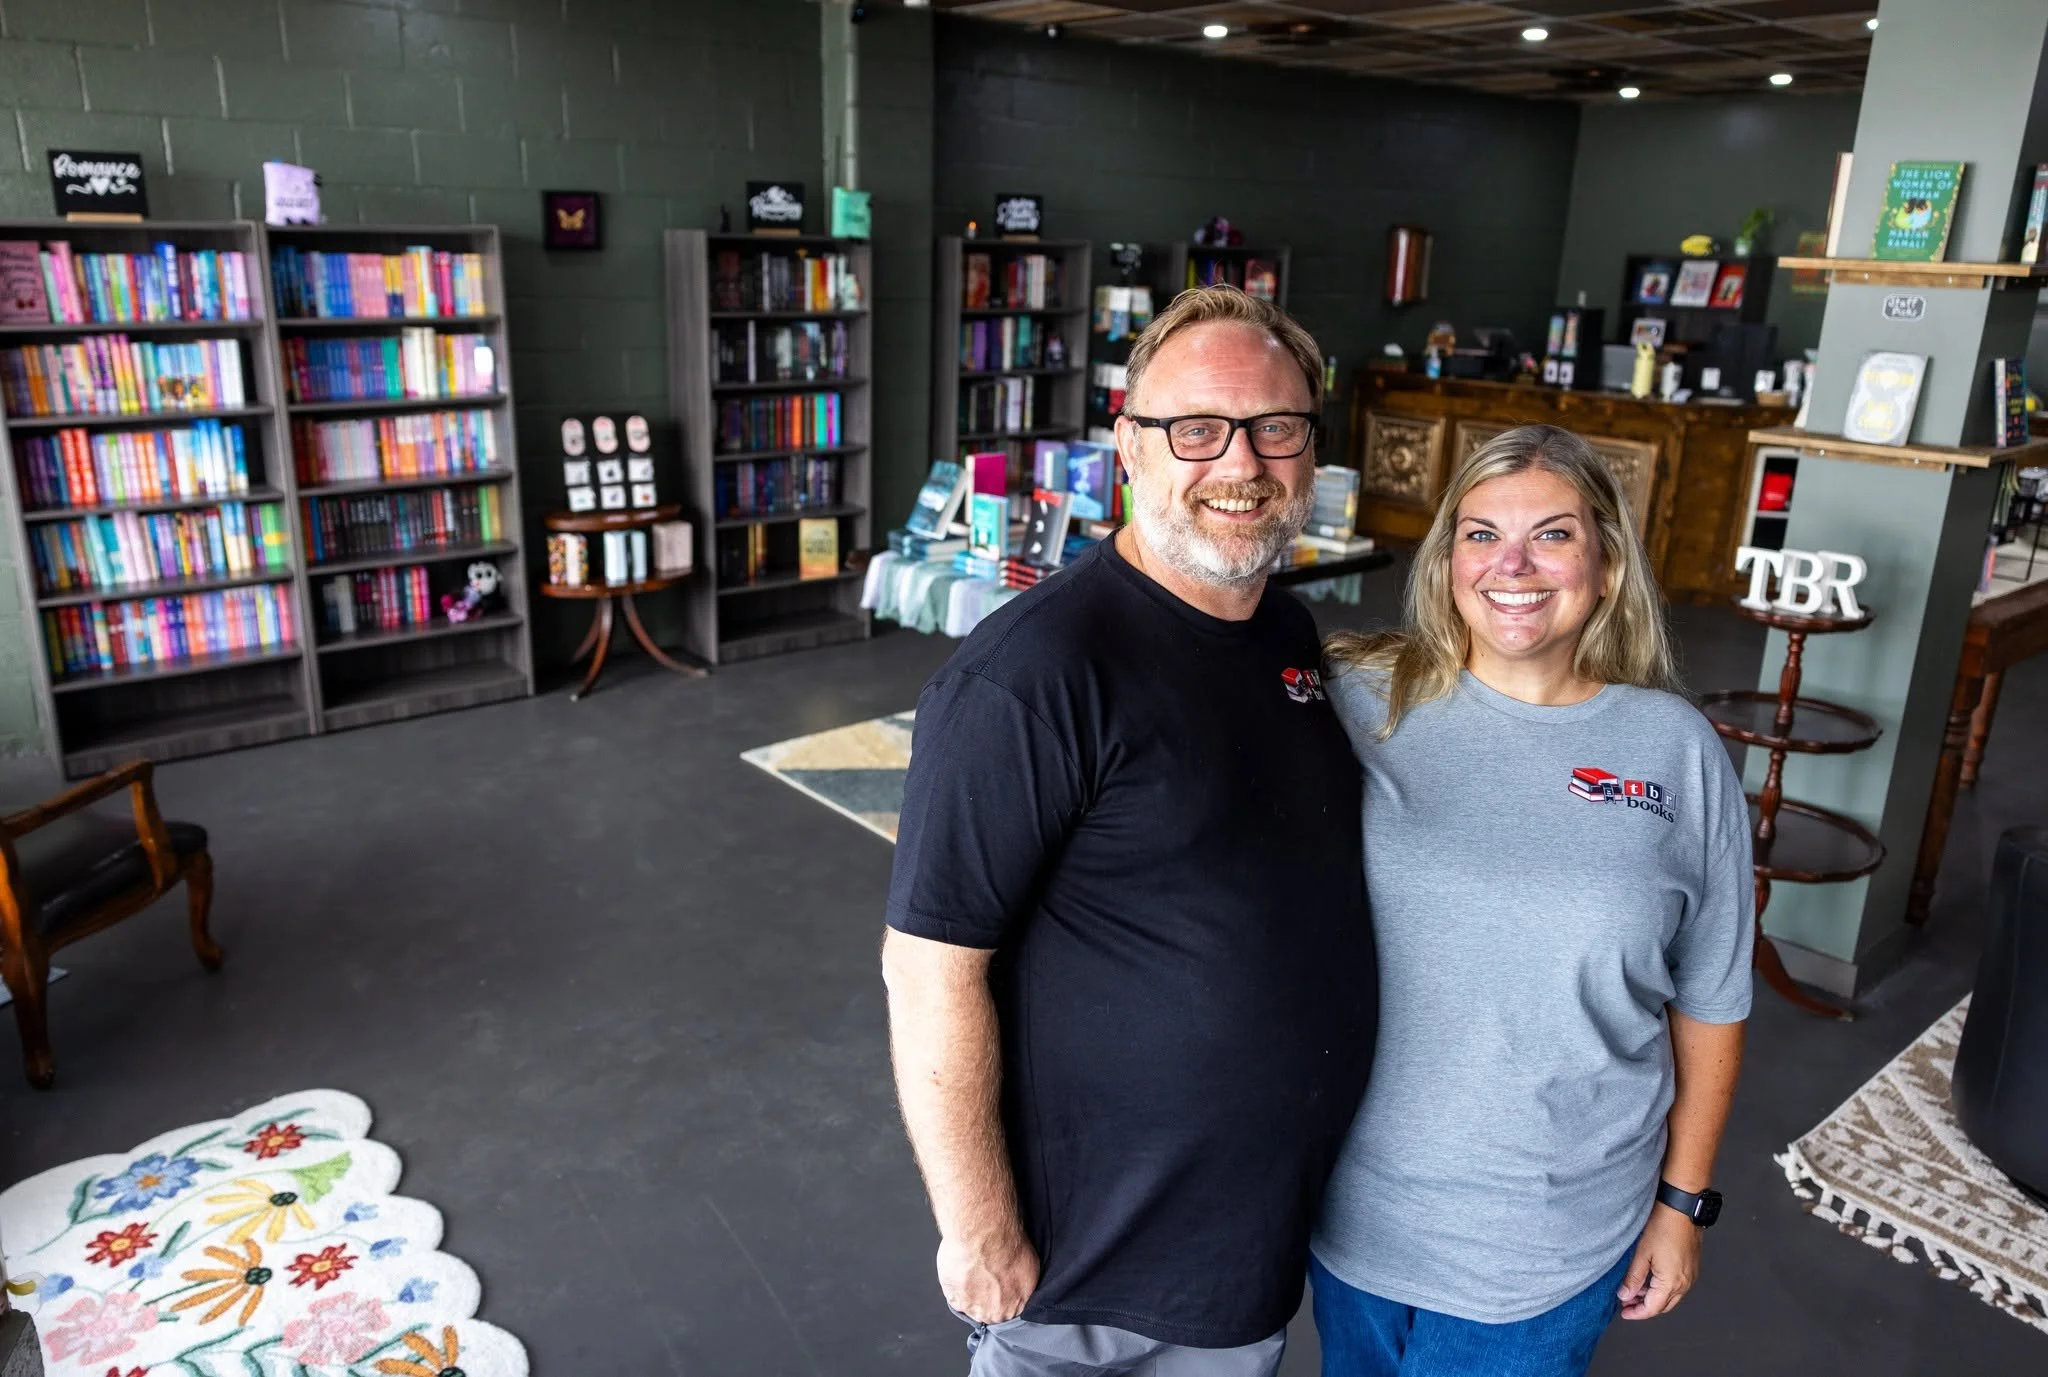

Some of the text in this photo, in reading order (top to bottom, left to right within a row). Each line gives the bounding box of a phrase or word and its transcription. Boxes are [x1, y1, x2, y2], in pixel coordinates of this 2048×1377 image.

[53, 153, 141, 178] Romance
[1900, 169, 1951, 180] THE LION
[1892, 180, 1954, 190] WOMEN OF
[1734, 546, 1868, 619] TBR
[1627, 781, 1675, 808] tbr
[1626, 797, 1675, 823] books
